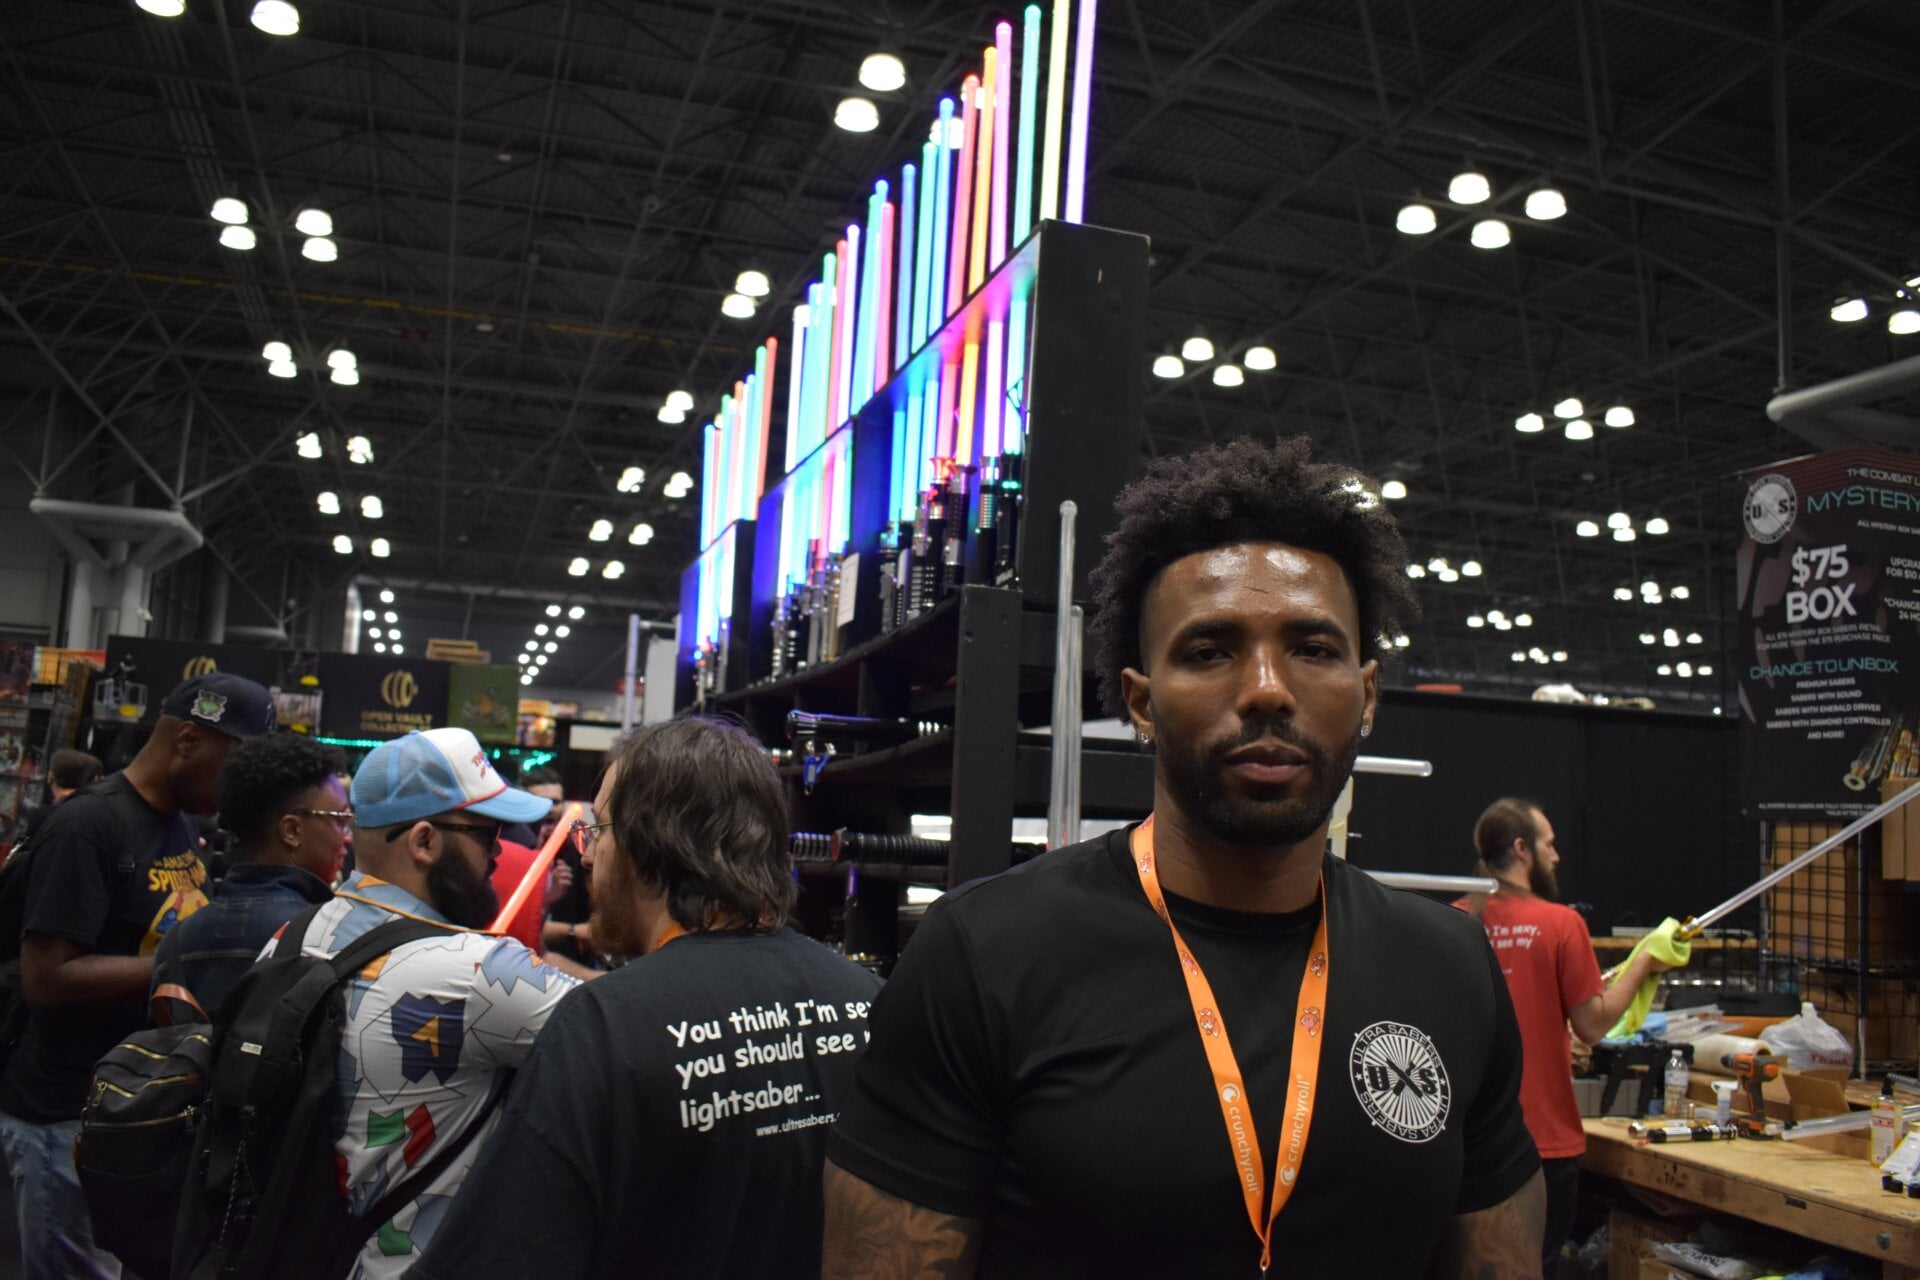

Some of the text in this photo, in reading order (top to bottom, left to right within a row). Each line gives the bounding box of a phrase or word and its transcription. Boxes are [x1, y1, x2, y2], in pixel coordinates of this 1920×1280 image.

[1846, 467, 1869, 478] THE
[1869, 468, 1912, 484] COMBAT
[1807, 485, 1920, 514] MYSTERY
[1792, 545, 1849, 588] $75
[1885, 566, 1903, 577] FOR
[1786, 583, 1857, 624] BOX
[1898, 610, 1909, 620] 24
[1750, 656, 1898, 680] CHANCE TO UNBOX
[1796, 677, 1856, 689] PREMIUM SABERS
[1791, 690, 1862, 703] SABERS WITH SOUND
[361, 711, 432, 725] OPEN VAULT
[1775, 702, 1881, 716] SABERS WITH EMERALD DRIVER
[1766, 716, 1891, 729] SABERS WITH DIAMOND CONTROLLER
[1807, 730, 1822, 739] AND
[1497, 939, 1513, 949] see
[1516, 938, 1533, 949] my
[728, 1001, 790, 1034] think
[795, 999, 838, 1026] I'm
[845, 1001, 872, 1019] se
[1353, 1024, 1440, 1068] ULTRA SABERS
[675, 1032, 856, 1090] you should see
[680, 1080, 821, 1132] lightsaber...
[1361, 1091, 1448, 1139] ULTRA SABERS
[1288, 1080, 1311, 1162] crunchyroll
[1229, 1106, 1259, 1192] crunchyroll
